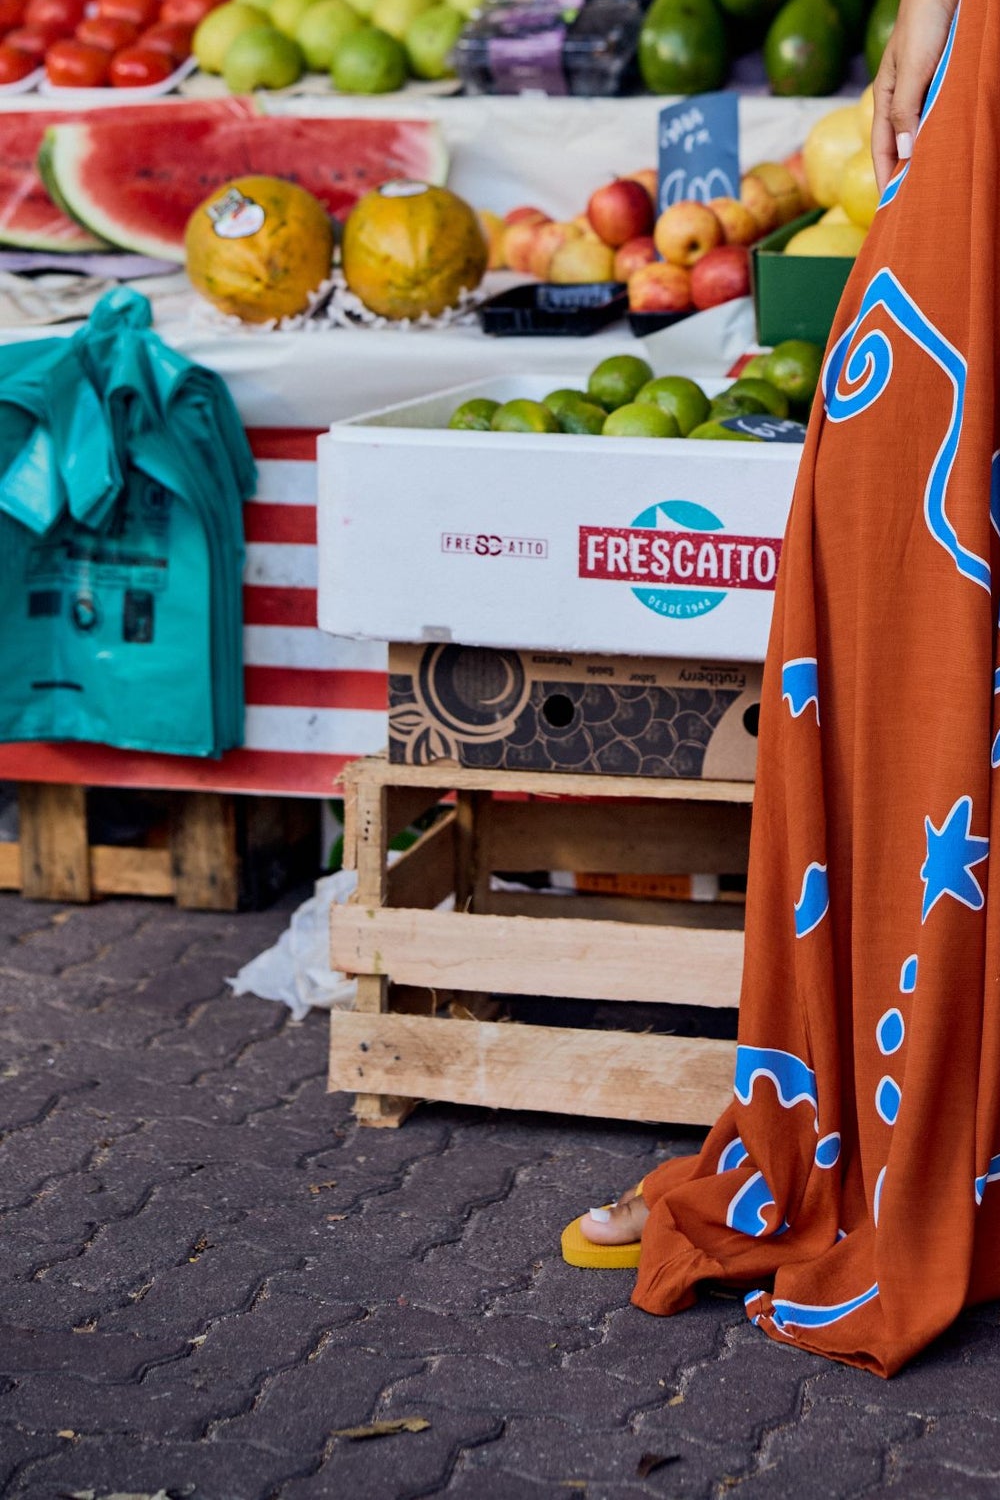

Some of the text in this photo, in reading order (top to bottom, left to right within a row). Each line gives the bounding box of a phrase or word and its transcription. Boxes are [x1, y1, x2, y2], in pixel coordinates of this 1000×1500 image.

[586, 533, 777, 583] FRESCATTO
[648, 595, 712, 615] DESDE 1944
[678, 668, 747, 688] Frutiberry
